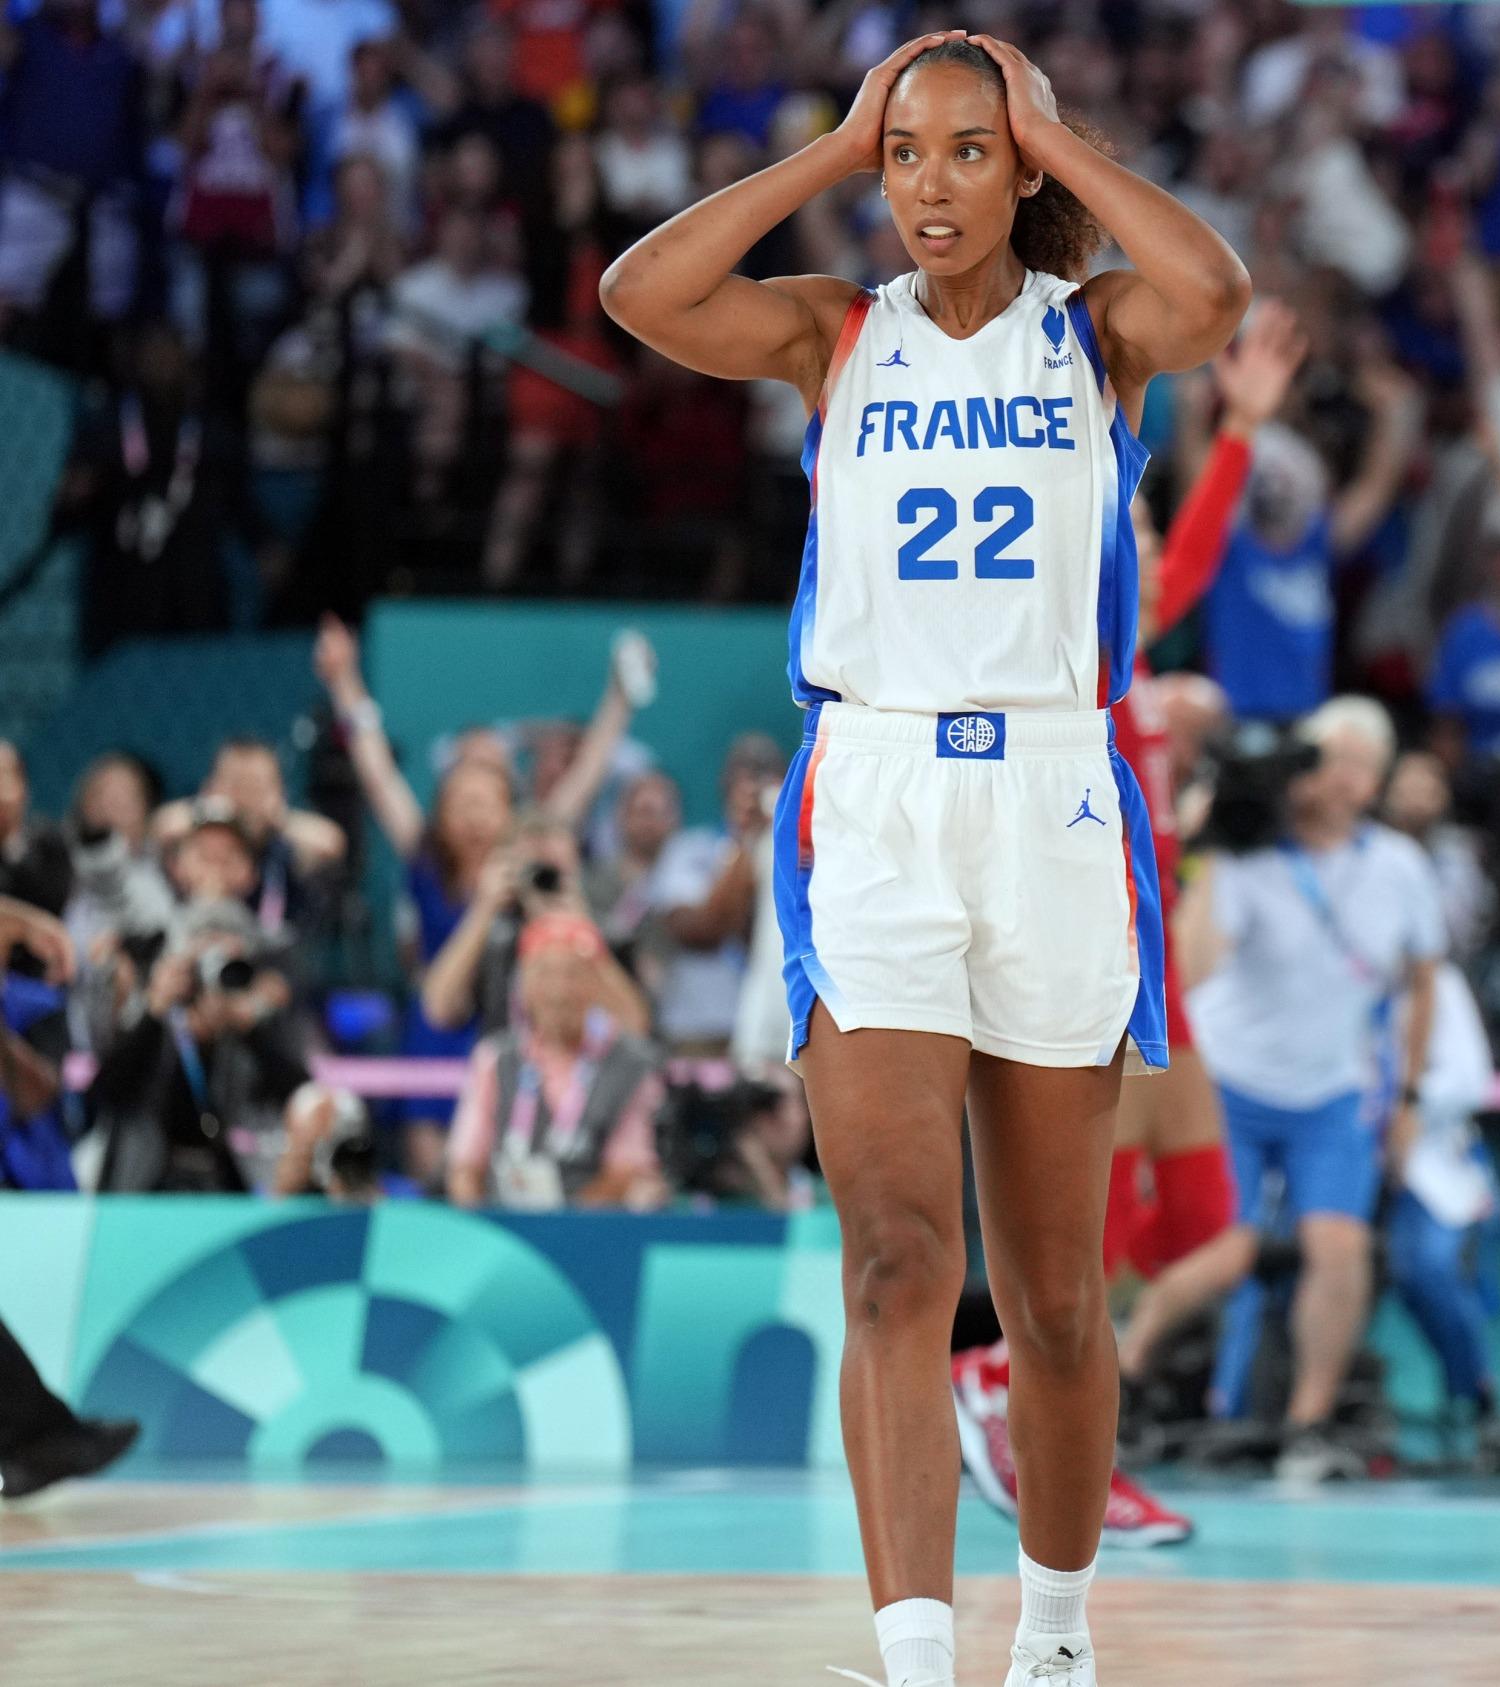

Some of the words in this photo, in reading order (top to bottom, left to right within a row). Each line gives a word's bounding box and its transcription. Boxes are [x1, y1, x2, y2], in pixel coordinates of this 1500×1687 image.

[1043, 352, 1074, 370] FRANCE
[856, 395, 1076, 458] FRANCE
[896, 486, 1035, 581] 22
